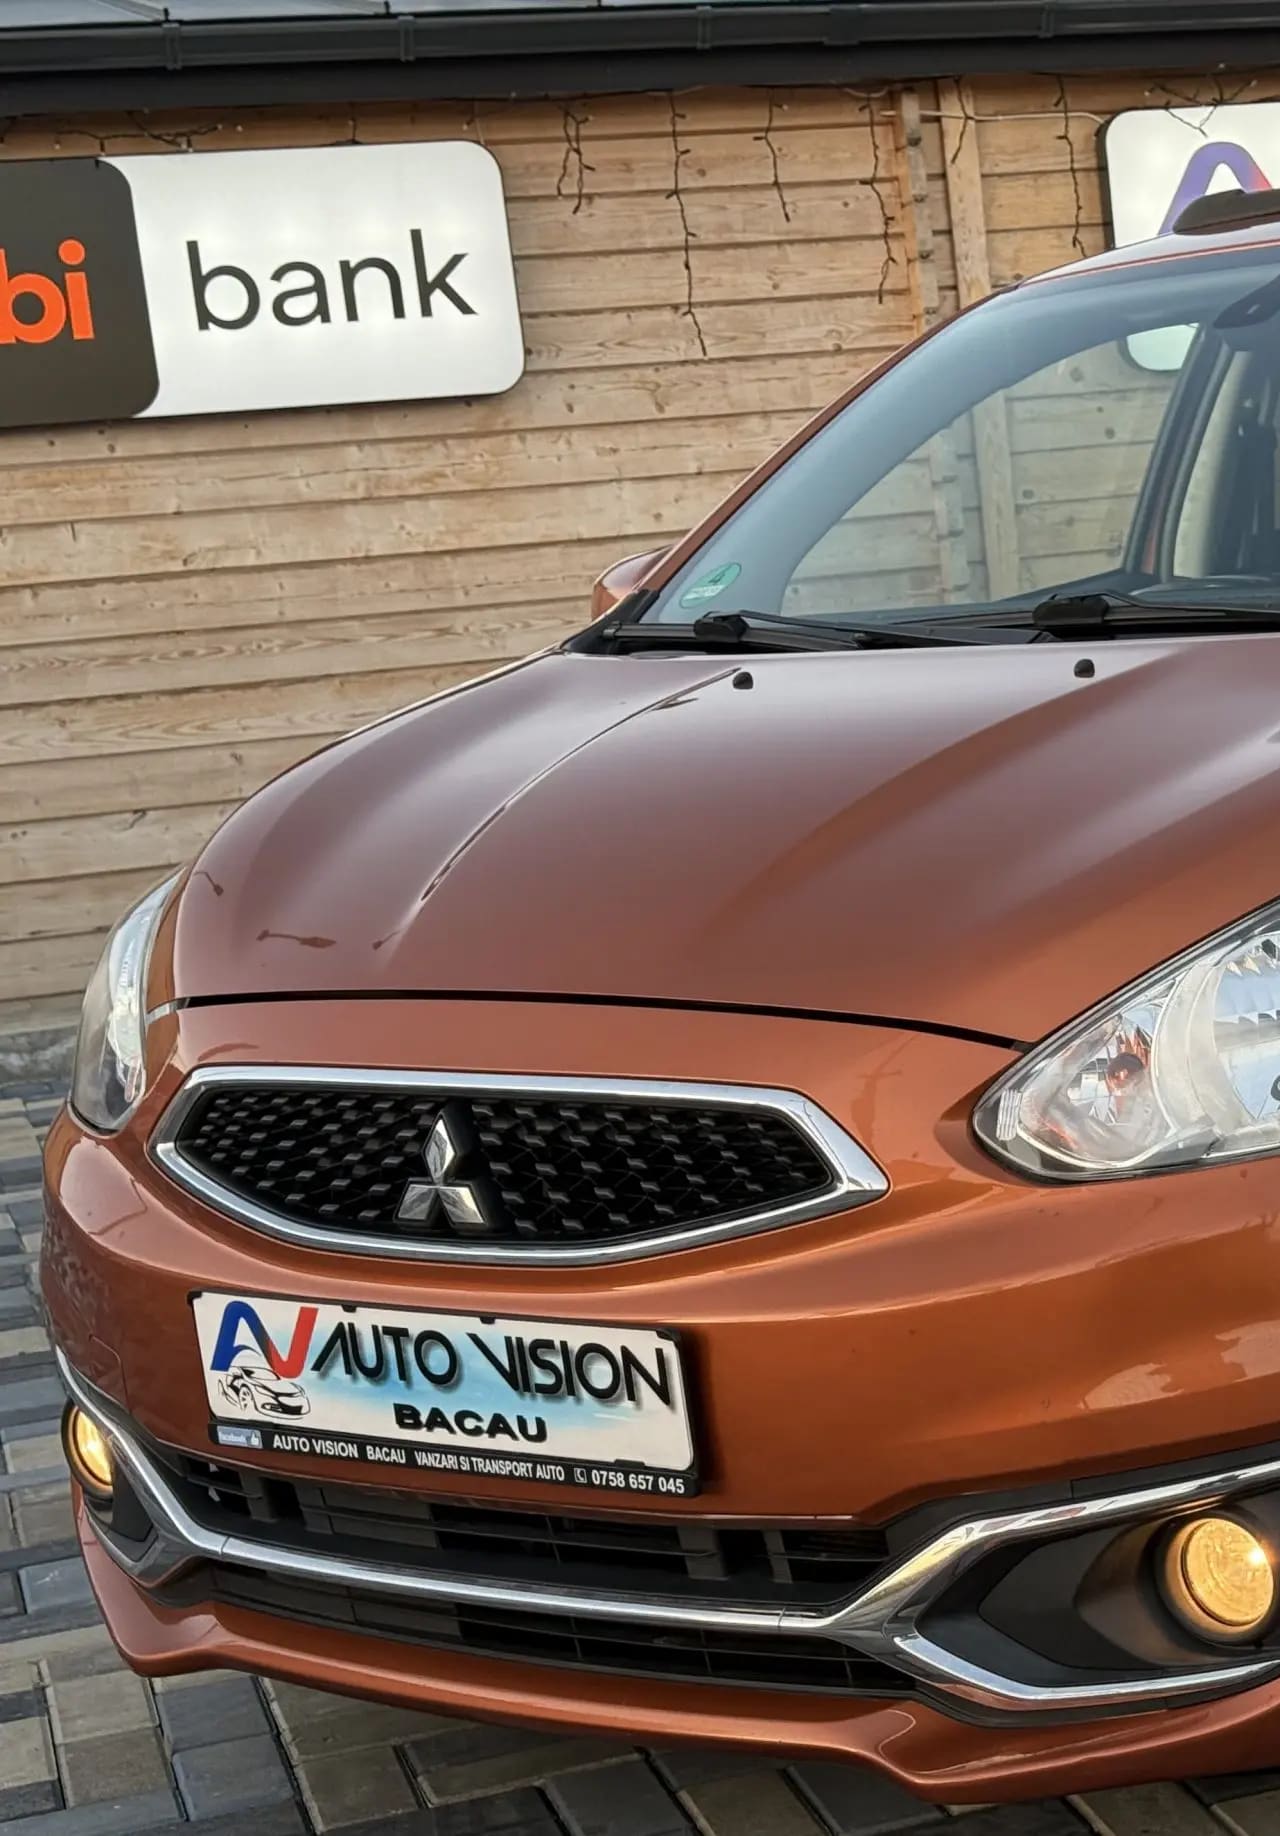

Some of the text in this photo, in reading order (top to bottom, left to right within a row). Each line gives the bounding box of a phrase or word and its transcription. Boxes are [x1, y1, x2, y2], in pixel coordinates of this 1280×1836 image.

[186, 229, 478, 331] bank
[311, 1321, 672, 1406] AUTO VISION
[393, 1402, 548, 1443] BACAU
[273, 1434, 685, 1494] AUTO VISION BACAU VANZARI SI TRANSPORT AUTO 0758 657 045
